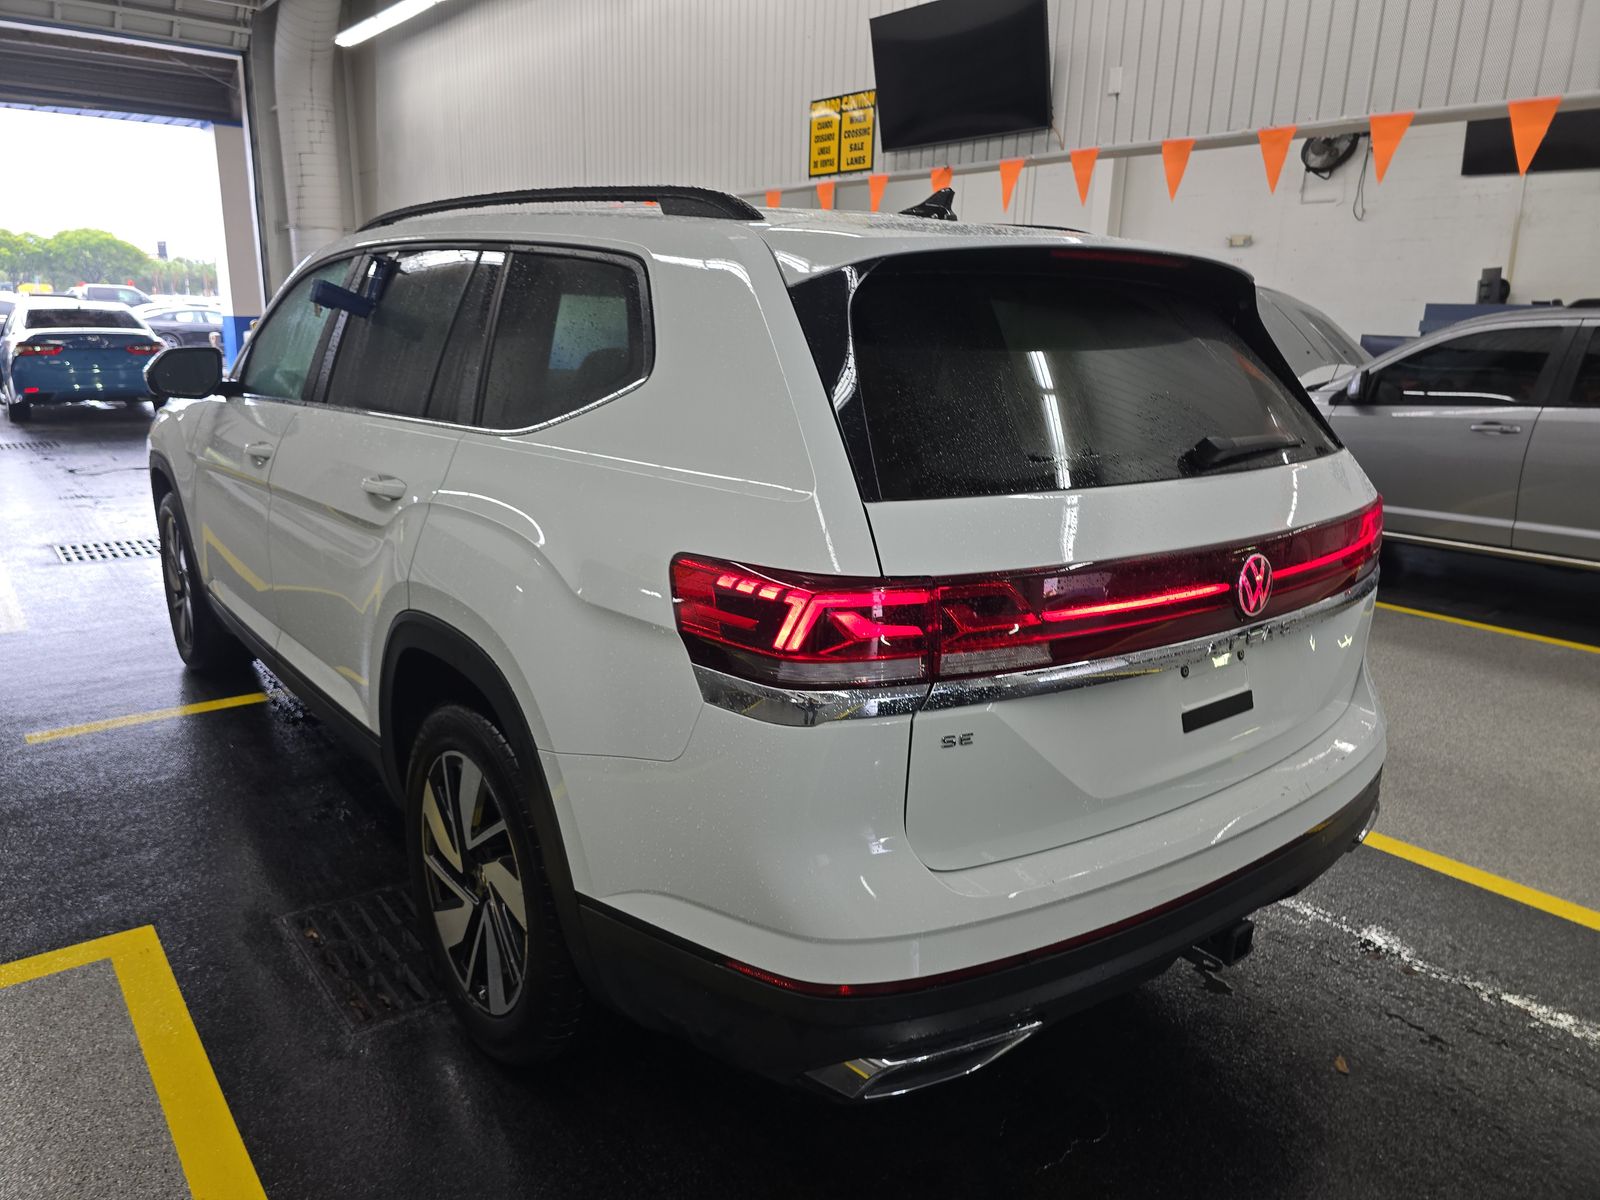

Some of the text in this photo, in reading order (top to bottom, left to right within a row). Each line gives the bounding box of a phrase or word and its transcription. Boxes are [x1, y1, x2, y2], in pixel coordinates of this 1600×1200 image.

[844, 127, 871, 139] CROSSING
[849, 142, 865, 152] SALE
[846, 156, 866, 166] LANES
[941, 732, 973, 748] SE
